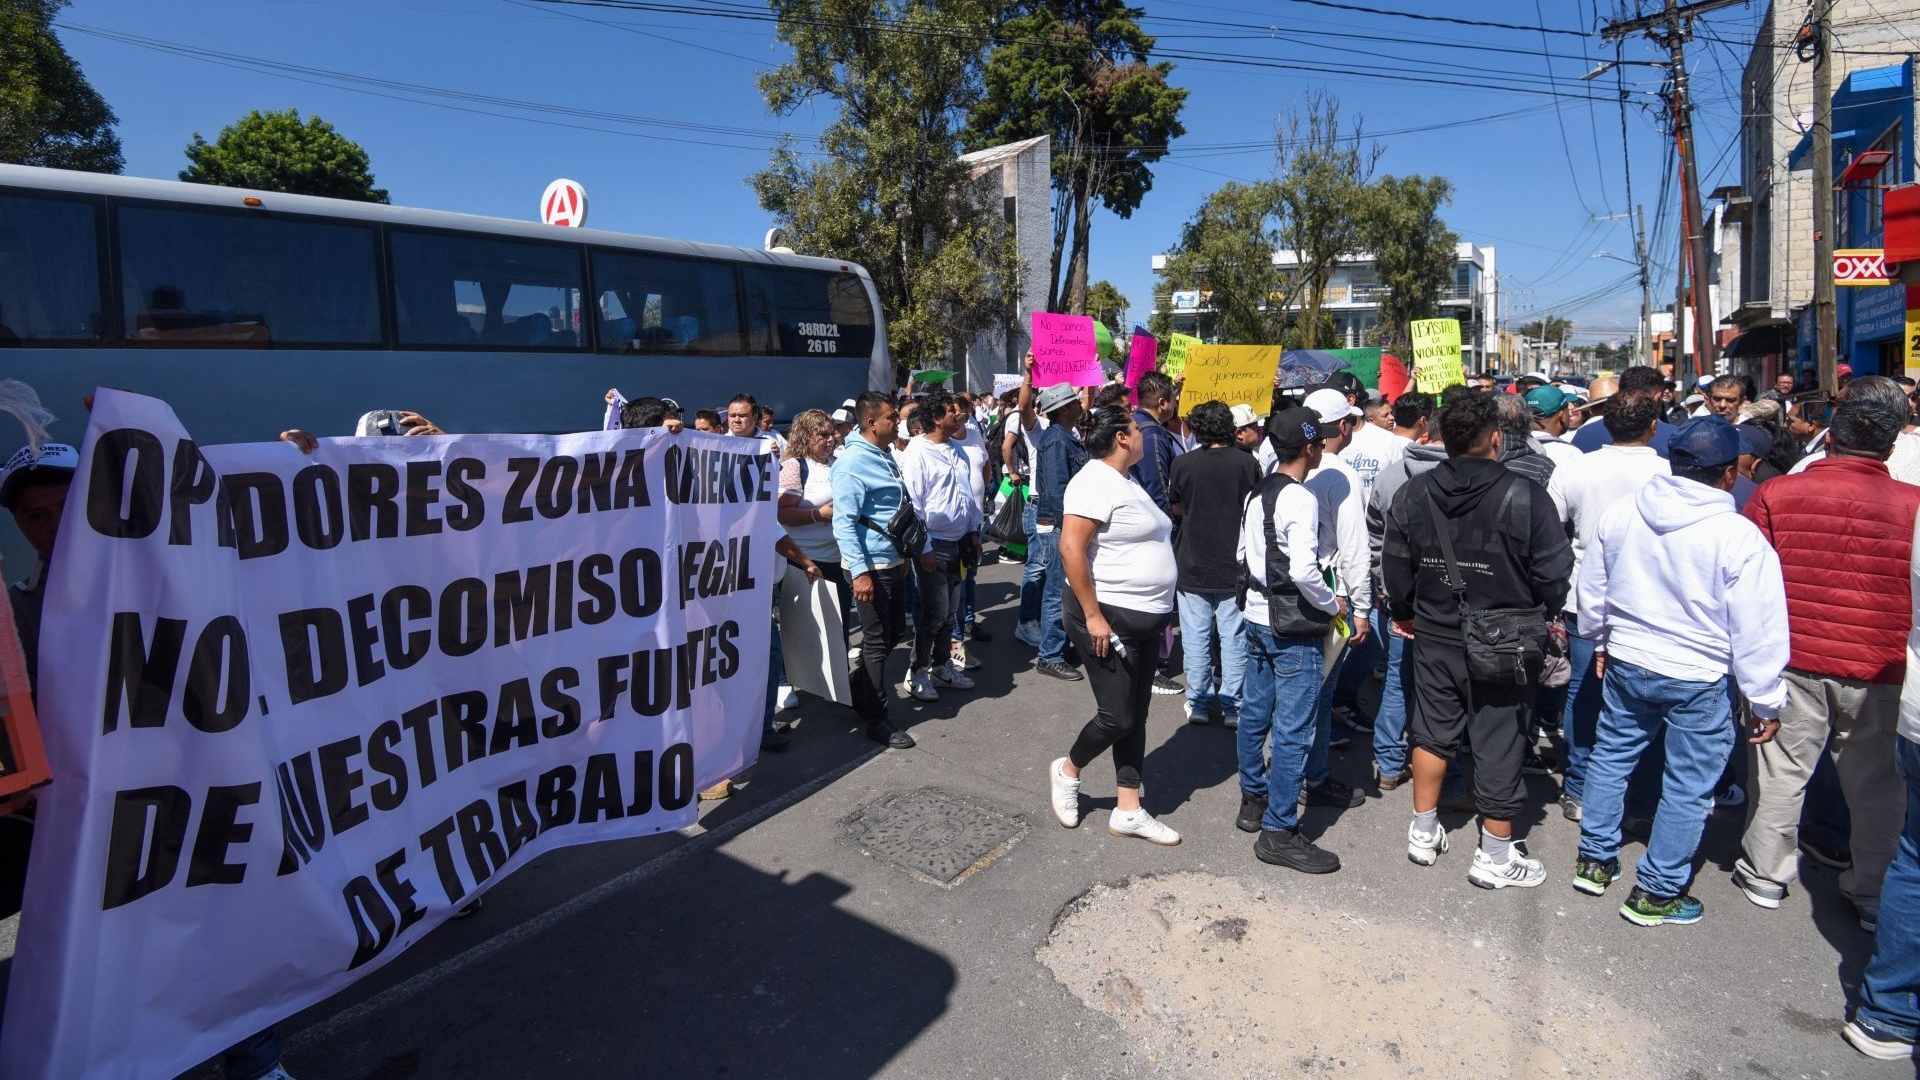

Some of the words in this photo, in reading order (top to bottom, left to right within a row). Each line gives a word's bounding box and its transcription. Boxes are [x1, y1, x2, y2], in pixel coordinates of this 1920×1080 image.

[1834, 255, 1900, 281] OXXO
[1040, 318, 1051, 331] No
[1413, 321, 1453, 338] ¡BASTA!
[807, 339, 836, 353] 2616
[1415, 344, 1460, 359] VIOLACIONES
[1210, 370, 1264, 387] queremos
[5, 446, 68, 471] OPERAORES
[501, 448, 652, 526] ZONA
[663, 443, 772, 505] ORIENTE
[279, 547, 663, 706] DECOMISO
[102, 781, 262, 912] DE
[275, 666, 582, 876] NUESTRAS
[342, 849, 428, 972] DE
[419, 742, 695, 905] TRABAJO
